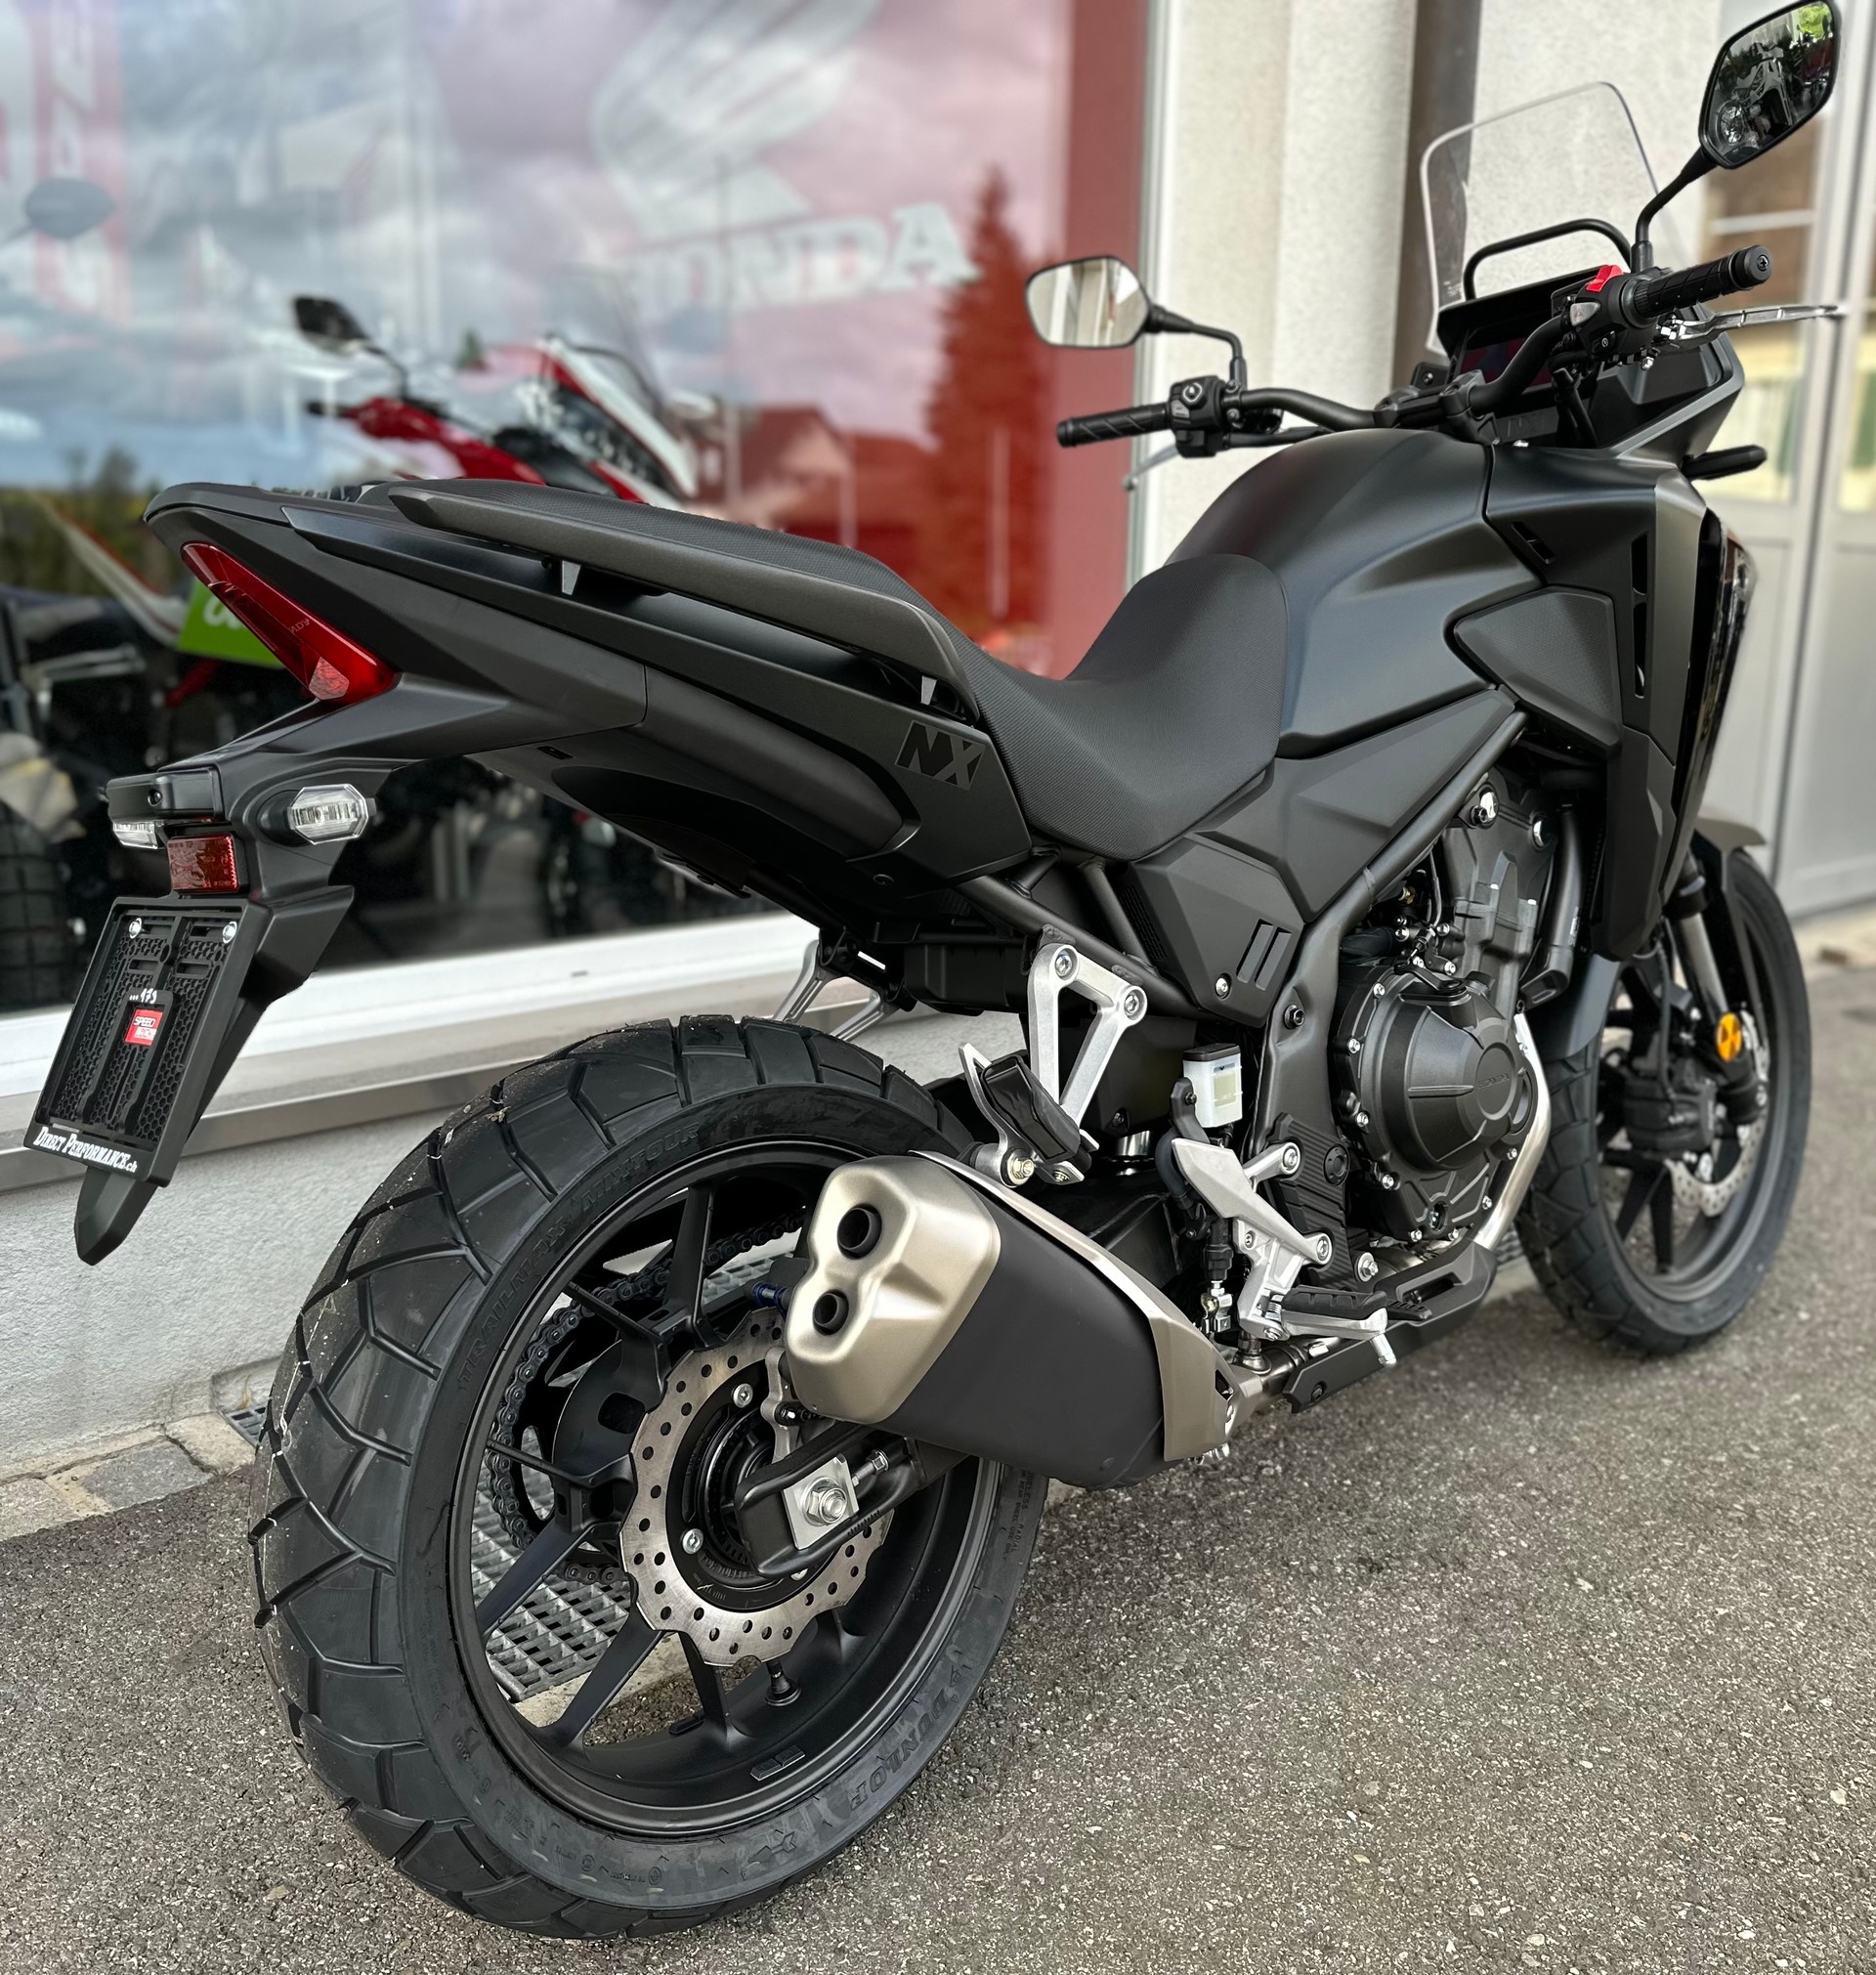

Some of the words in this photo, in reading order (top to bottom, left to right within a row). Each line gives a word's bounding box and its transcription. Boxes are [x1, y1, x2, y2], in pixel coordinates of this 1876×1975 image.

[894, 720, 986, 791] NX
[133, 1015, 156, 1027] SPEED
[33, 1126, 66, 1152] DIRECT
[850, 1688, 949, 1812] DUNLOP
